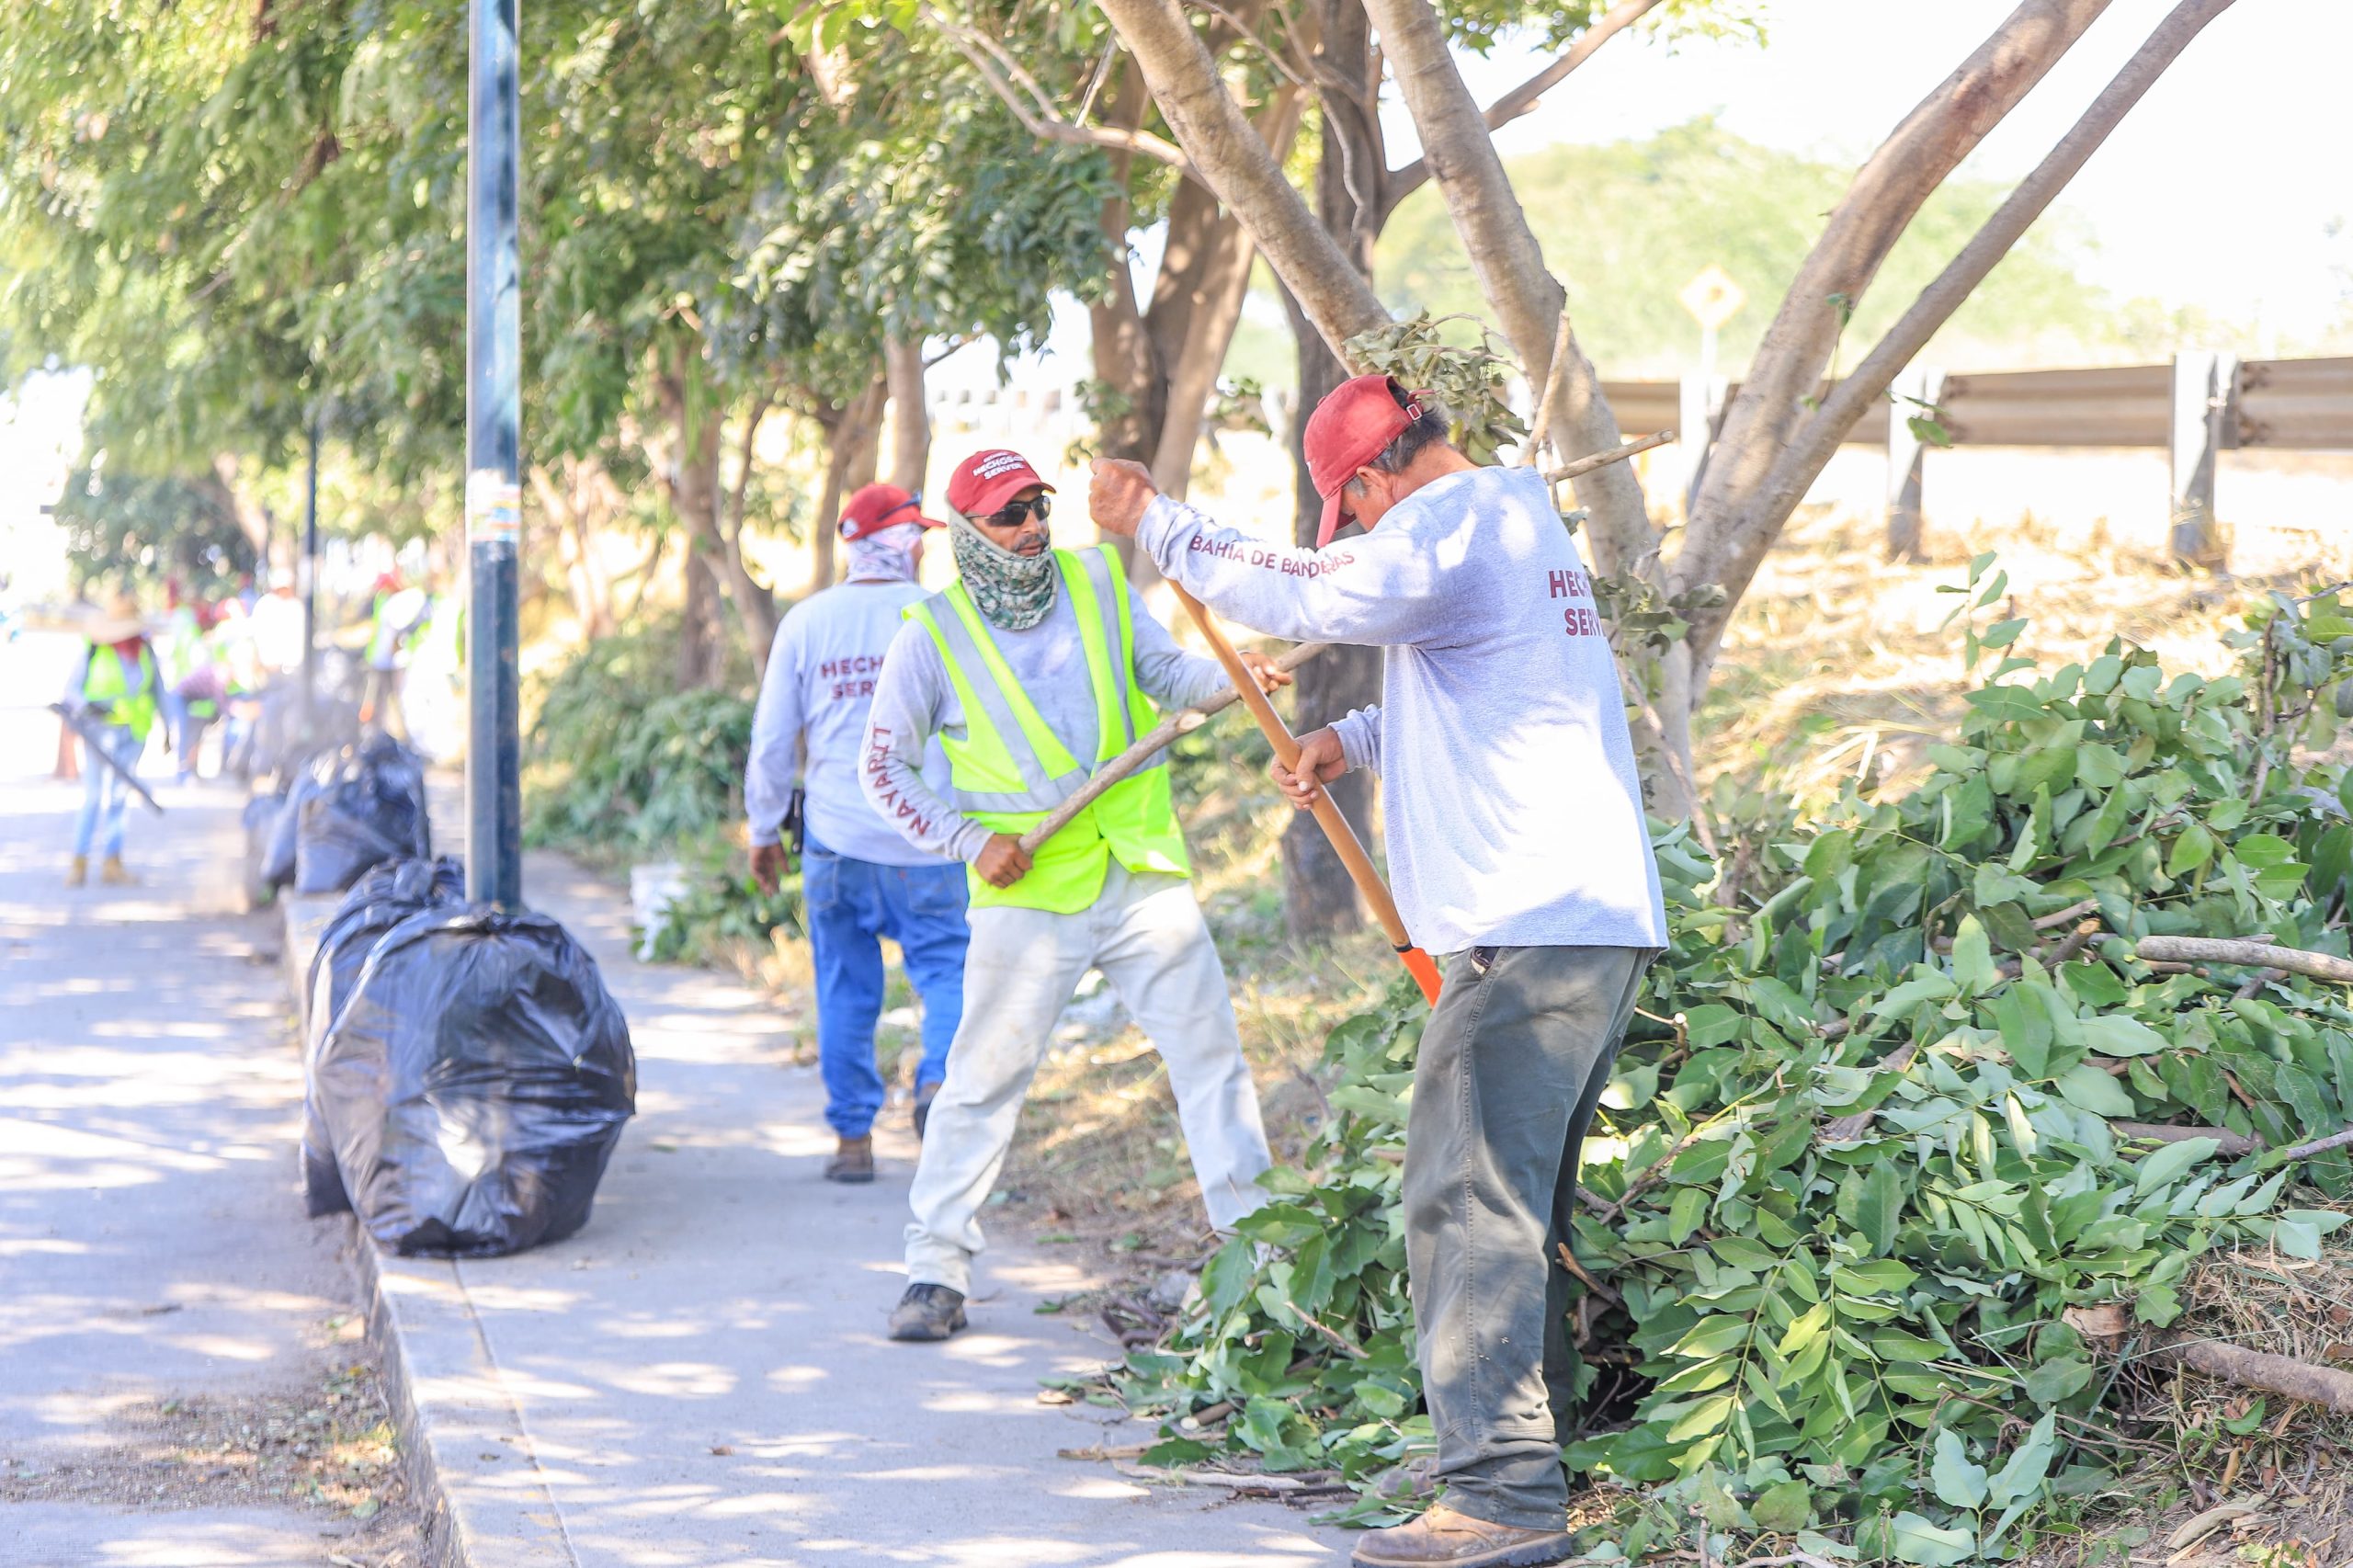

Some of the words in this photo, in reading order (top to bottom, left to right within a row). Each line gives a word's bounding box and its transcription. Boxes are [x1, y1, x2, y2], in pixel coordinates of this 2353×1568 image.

[1251, 550, 1278, 570] DE
[1281, 551, 1356, 579] BANDERAS
[867, 722, 931, 836] NAYARIT
